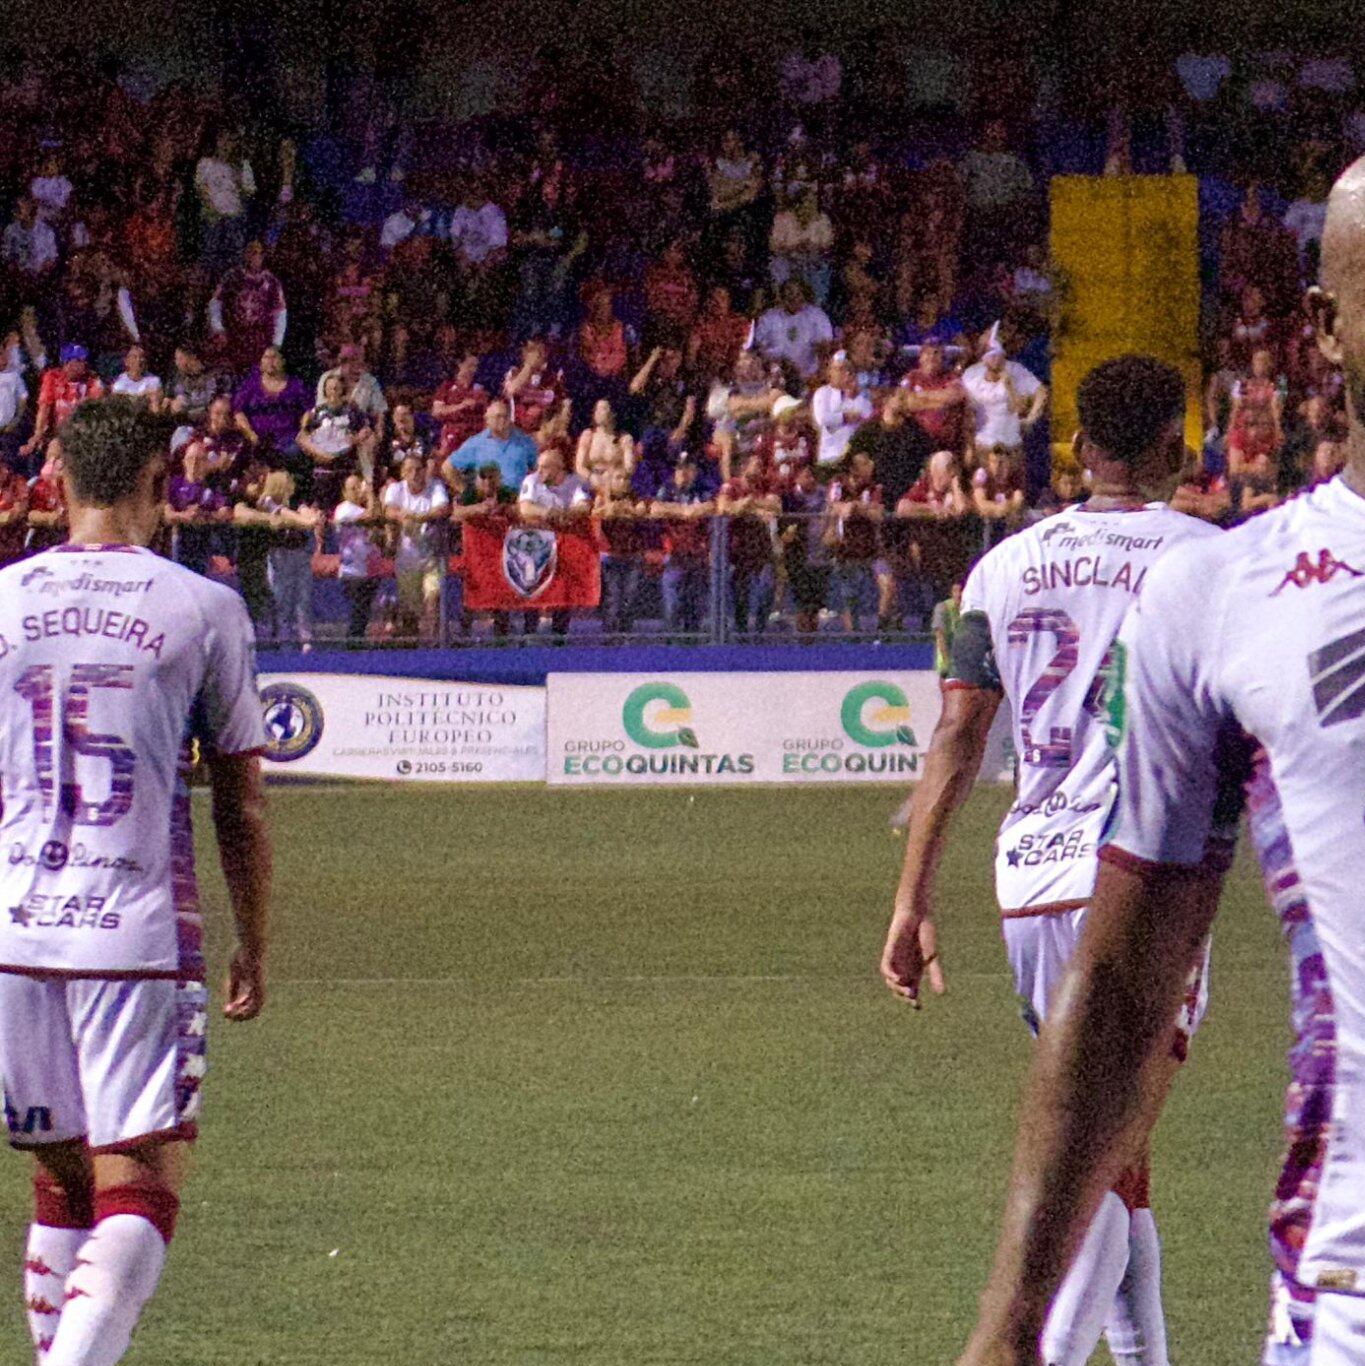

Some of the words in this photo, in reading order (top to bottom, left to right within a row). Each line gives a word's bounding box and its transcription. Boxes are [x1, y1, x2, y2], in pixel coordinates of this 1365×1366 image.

[1022, 555, 1148, 594] SINCLAI
[22, 606, 166, 658] SEQUEIRA
[1007, 607, 1108, 767] 2
[378, 693, 504, 708] INSTITUTO
[365, 707, 517, 726] POLITÉCNICO
[389, 730, 492, 744] EUROPEO
[564, 739, 626, 753] GRUPO
[782, 738, 844, 752] GRUPO
[563, 754, 755, 775] ECOQUINTAS
[782, 752, 928, 774] ECOQUIN
[1018, 830, 1083, 851] STAR
[1024, 843, 1093, 865] CARS
